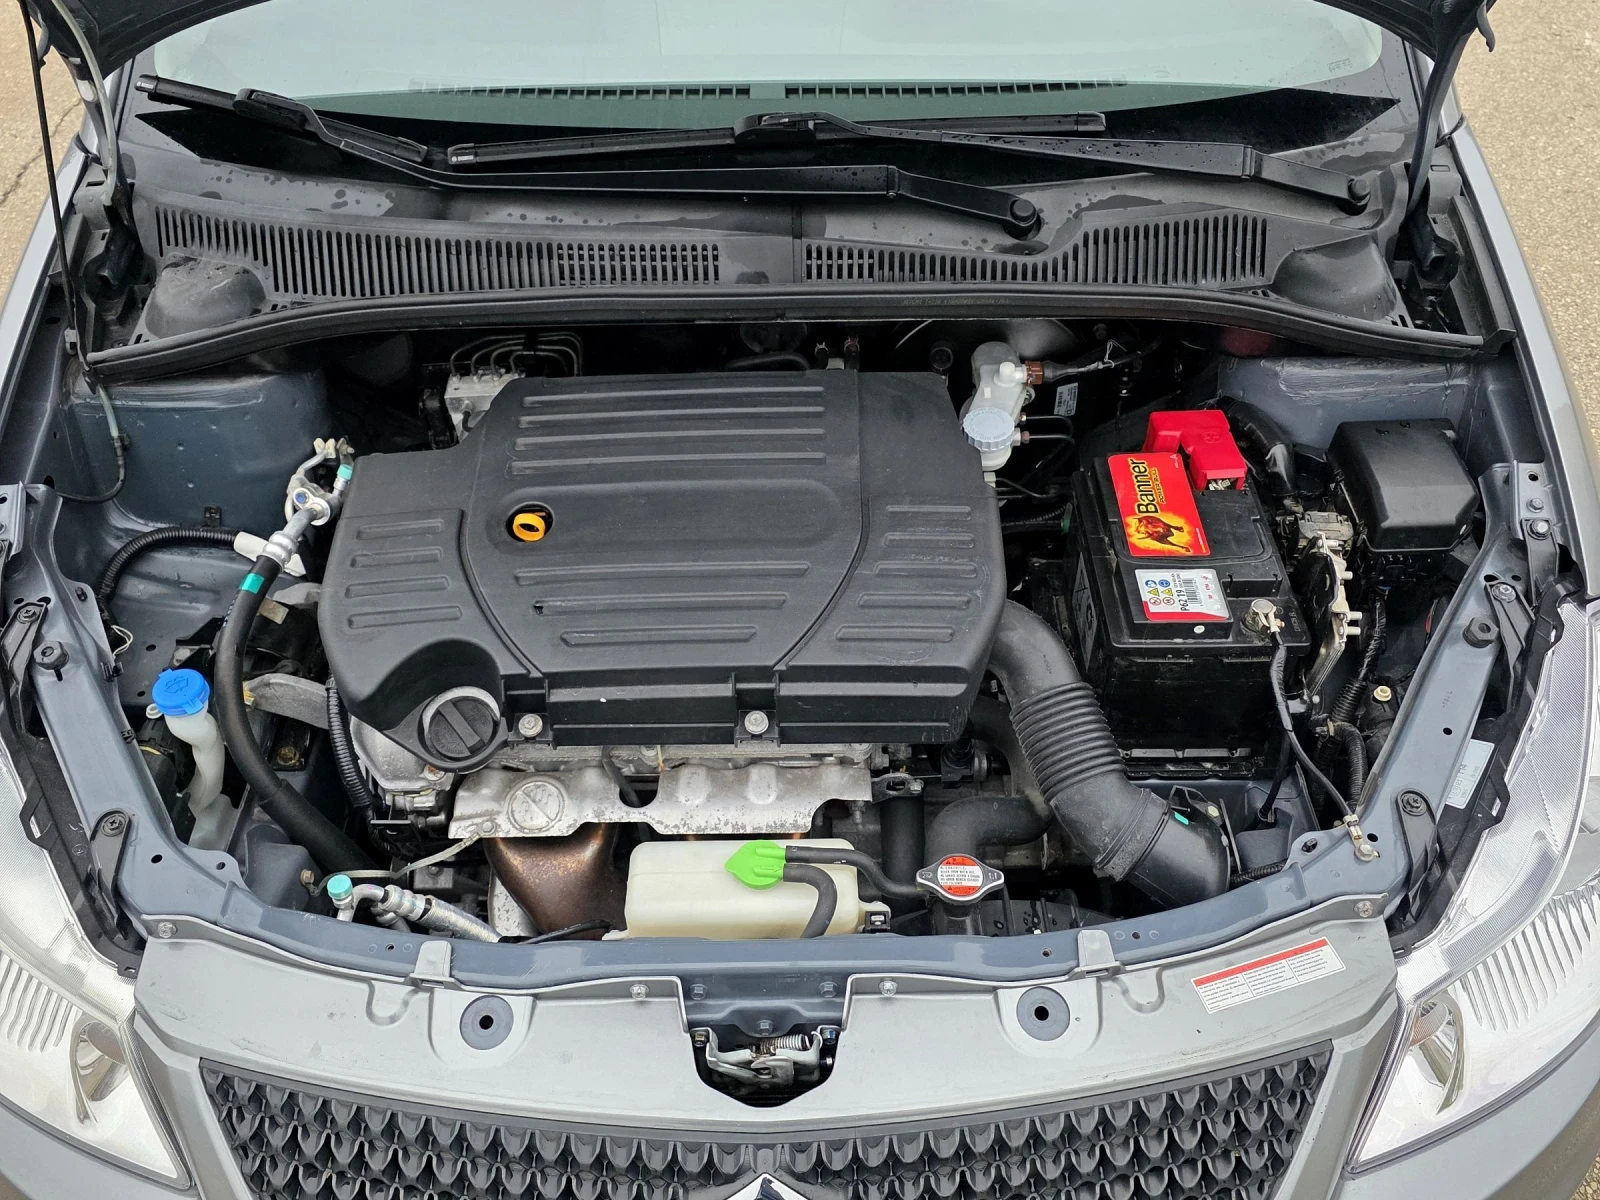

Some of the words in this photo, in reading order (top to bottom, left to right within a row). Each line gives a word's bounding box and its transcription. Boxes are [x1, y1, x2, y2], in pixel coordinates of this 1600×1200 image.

[1152, 469, 1160, 483] BULL
[1130, 458, 1159, 514] Banner
[1156, 484, 1165, 504] POWER
[1176, 589, 1186, 598] 19
[1178, 598, 1190, 611] P62
